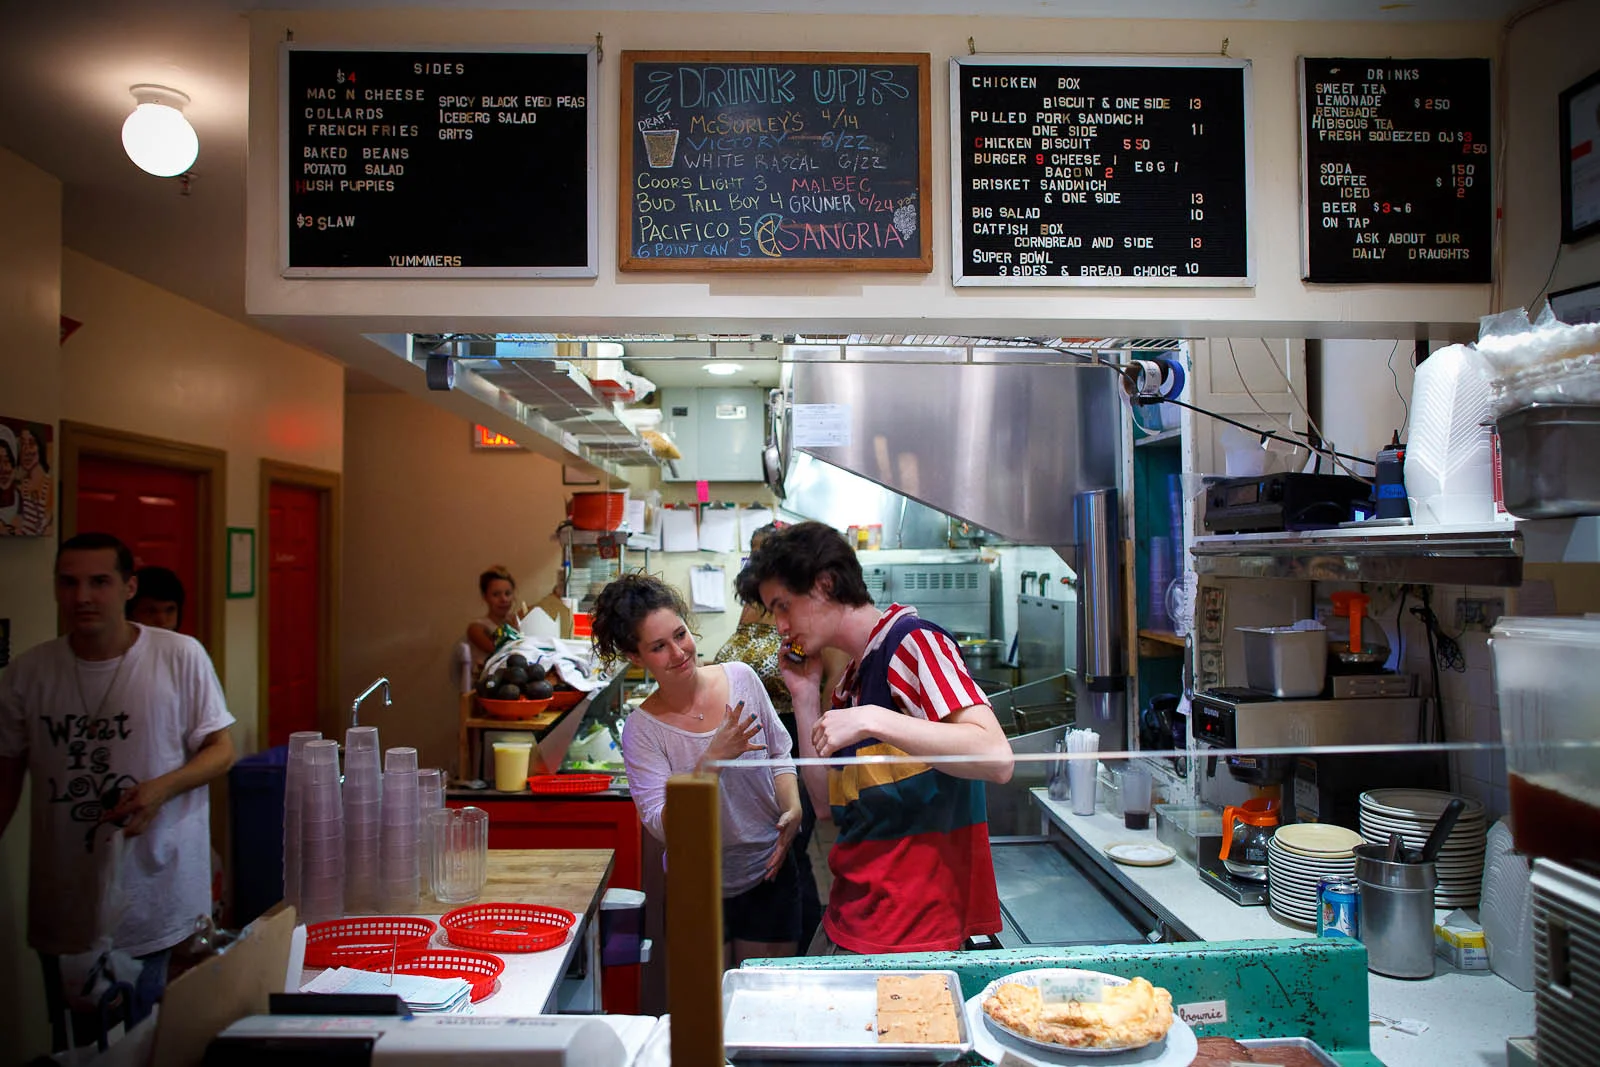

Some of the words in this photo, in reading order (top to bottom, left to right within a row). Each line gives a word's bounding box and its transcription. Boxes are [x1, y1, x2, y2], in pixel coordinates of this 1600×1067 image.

[414, 63, 464, 74] SIDES
[1367, 68, 1419, 80] DRINKS
[679, 67, 797, 107] DRINK
[813, 69, 867, 105] UP!
[972, 77, 1036, 88] CHICKEN
[1058, 77, 1080, 89] BOX
[1315, 83, 1354, 94] SWEET
[1361, 83, 1386, 94] TEA
[307, 88, 336, 99] MAC
[346, 88, 355, 100] N
[365, 89, 424, 100] CHEESE
[439, 96, 474, 107] SPICY
[482, 96, 518, 107] BLACK
[525, 96, 551, 107] EYED
[557, 96, 585, 108] PEAS
[1043, 97, 1095, 108] BISCUIT
[1102, 97, 1110, 108] &
[1116, 98, 1139, 109] ONE
[1144, 98, 1170, 109] SIDE
[1189, 98, 1201, 109] 13
[1317, 95, 1381, 106] LEMONADE
[305, 107, 383, 119] COLLARDS
[439, 109, 490, 123] ICEBERG
[498, 112, 536, 124] SALAD
[971, 111, 1026, 123] PULLED
[1036, 112, 1070, 123] PORK
[1315, 107, 1378, 117] RENEGADE
[637, 112, 672, 132] DRAFT
[821, 108, 859, 129] 4/14
[1312, 115, 1368, 129] HIBISCUS
[1374, 118, 1393, 130] TEA
[308, 124, 366, 136] FRENCH
[371, 125, 418, 137] FRIES
[438, 128, 472, 139] GRITS
[1032, 125, 1058, 136] ONE
[1068, 126, 1097, 136] SIDE
[1319, 130, 1361, 141] FRESH
[1369, 131, 1430, 142] SQUEEZED
[1438, 132, 1453, 142] OJ
[686, 133, 787, 150] VICTORY
[975, 138, 1031, 148] CHICKEN
[1041, 138, 1090, 149] BISCUIT
[303, 146, 347, 158] BAKED
[362, 148, 409, 159] BEANS
[684, 152, 744, 168] WHITE
[754, 153, 819, 173] RASCAL
[974, 153, 1026, 164] BURGER
[1036, 153, 1043, 164] 9
[1051, 154, 1100, 165] CHEESE
[304, 163, 346, 175] POTATO
[365, 164, 404, 175] SALAD
[1045, 167, 1093, 178] BACON
[1105, 167, 1113, 178] 2
[1320, 163, 1352, 174] SODA
[295, 179, 333, 193] HUSH
[340, 180, 395, 192] PUPPIES
[637, 172, 692, 189] COORS
[700, 175, 744, 190] LIGHT
[753, 174, 766, 191] 3
[791, 176, 870, 192] MALBEC
[972, 179, 1030, 190] BRISKET
[1040, 179, 1106, 190] SANDWICH
[1320, 175, 1367, 186] COFFEE
[1045, 193, 1052, 203] &
[1062, 192, 1087, 203] ONE
[1095, 193, 1120, 203] SIDE
[1191, 193, 1203, 204] 13
[1340, 187, 1370, 198] ICED
[1456, 188, 1464, 198] 2
[637, 192, 675, 212] BUD
[682, 193, 722, 212] TALL
[729, 192, 759, 211] BOY
[770, 192, 782, 208] 4
[857, 193, 894, 212] 6/24
[1322, 202, 1356, 213] BEER
[972, 207, 992, 218] BIG
[1000, 207, 1040, 218] SALAD
[1191, 209, 1203, 220] 10
[297, 213, 313, 228] $3
[317, 215, 355, 230] SLAW
[1322, 216, 1338, 228] ON
[1347, 217, 1370, 228] TAP
[639, 215, 728, 242] PACIFICO
[739, 216, 752, 234] 5
[778, 218, 904, 250] SANGRIA
[1040, 223, 1063, 235] BOX
[1014, 236, 1081, 248] CORNBREAD
[1092, 237, 1113, 248] AND
[1124, 237, 1153, 248] SIDE
[1191, 237, 1201, 248] 13
[1356, 233, 1379, 244] ASK
[1388, 233, 1426, 244] ABOUT
[1436, 233, 1460, 244] OUR
[637, 244, 650, 258] 6
[655, 242, 698, 256] POINT
[704, 241, 728, 256] CAN
[738, 238, 751, 256] 5
[1353, 248, 1385, 259] DAILY
[1409, 248, 1469, 259] DRAUGHTS
[389, 255, 461, 267] YUMMMERS
[972, 248, 1011, 263] SUPER
[1020, 250, 1053, 264] BOWL
[999, 265, 1007, 276] 3
[1012, 265, 1047, 276] SIDES
[1061, 265, 1069, 276] &
[1080, 265, 1121, 276] BREAD
[1133, 265, 1177, 276] CHOICE
[1185, 262, 1198, 274] 10
[1179, 1008, 1223, 1022] brownie
